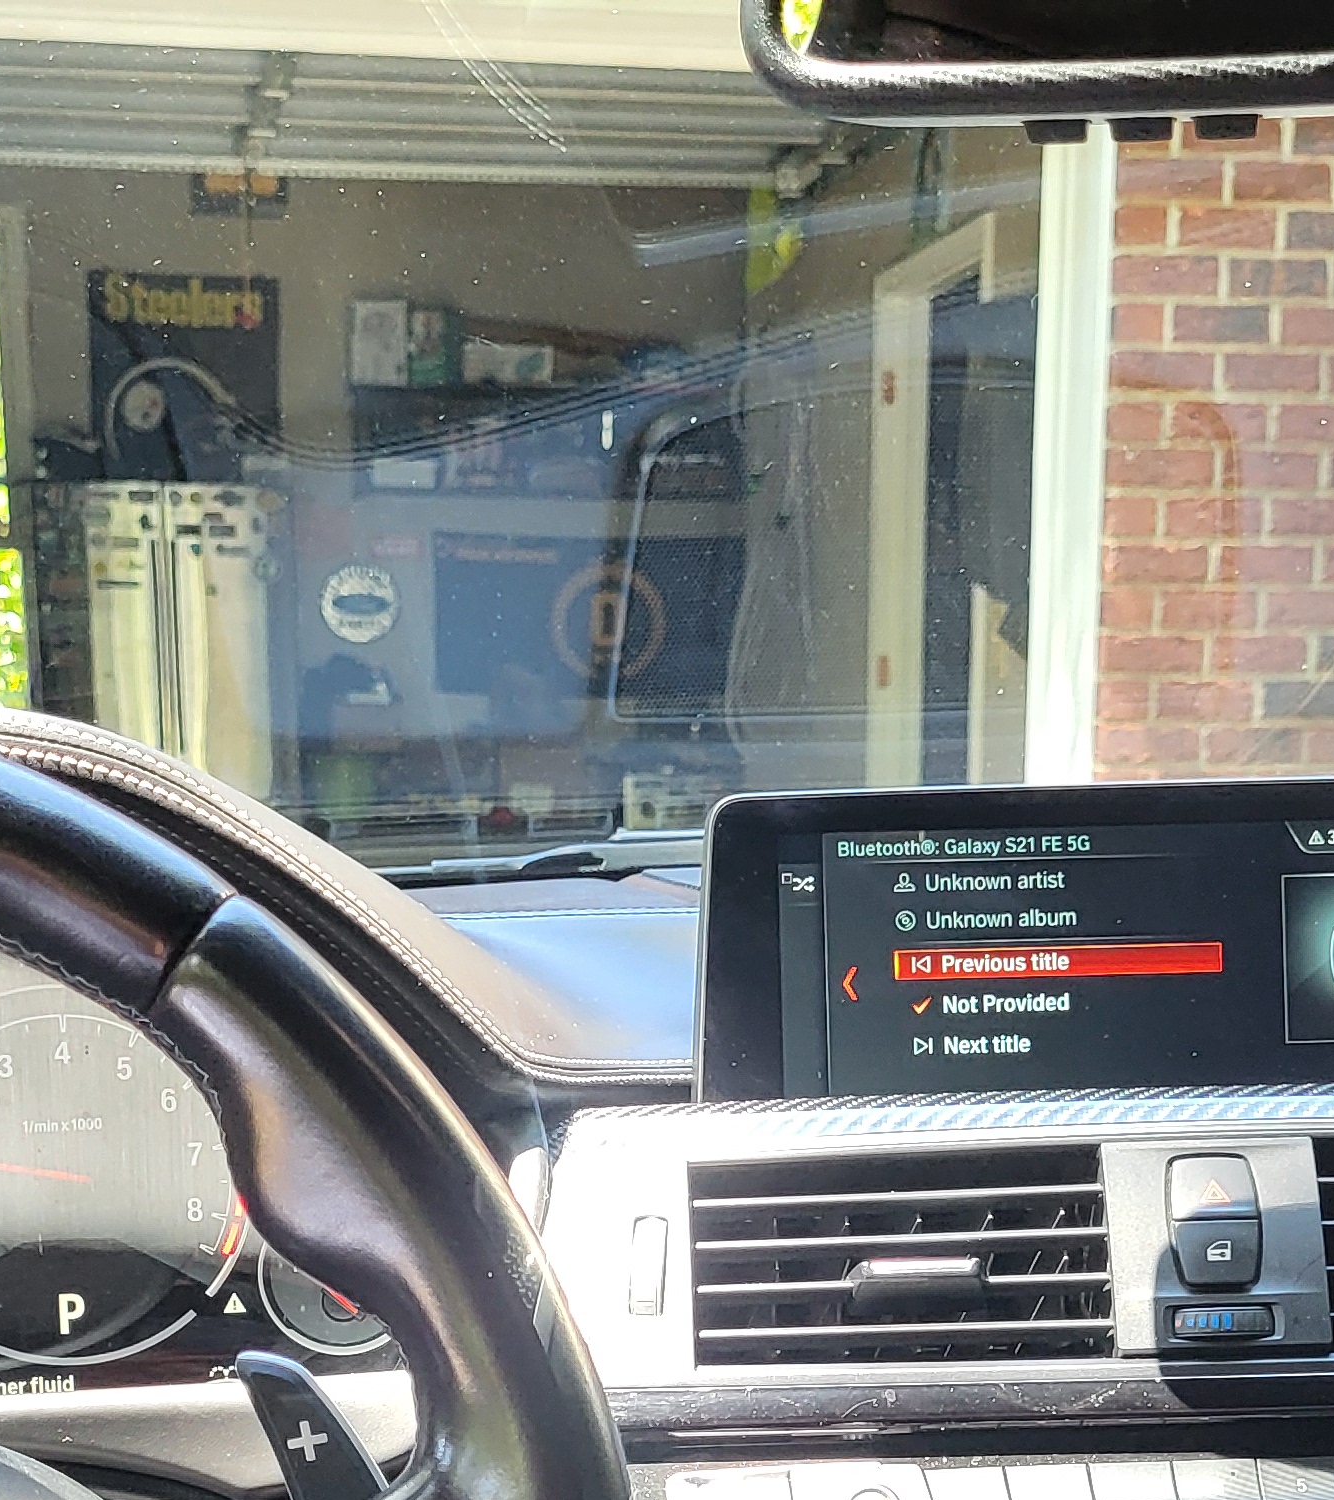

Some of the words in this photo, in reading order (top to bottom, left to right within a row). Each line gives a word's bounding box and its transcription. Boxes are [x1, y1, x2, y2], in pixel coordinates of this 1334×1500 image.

[944, 837, 1000, 857] Galaxy
[1005, 836, 1035, 853] S21
[1042, 836, 1063, 852] FE
[1067, 835, 1091, 852] 5G
[925, 873, 1012, 892] Unknown
[1017, 870, 1066, 890] artist
[926, 910, 1013, 930] Unknown
[1018, 908, 1078, 928] album
[941, 954, 1027, 973] Previous
[1030, 952, 1070, 971] title
[942, 995, 979, 1014] Not
[983, 992, 1070, 1012] Provided
[54, 1041, 71, 1065] 4
[943, 1035, 990, 1055] Next
[992, 1034, 1032, 1053] title
[116, 1057, 133, 1080] 5
[161, 1088, 177, 1112] 6
[188, 1142, 203, 1166] 7
[187, 1198, 203, 1222] 8
[58, 1293, 85, 1335] P
[30, 1374, 76, 1395] fluid
[1295, 1477, 1309, 1493] 5
